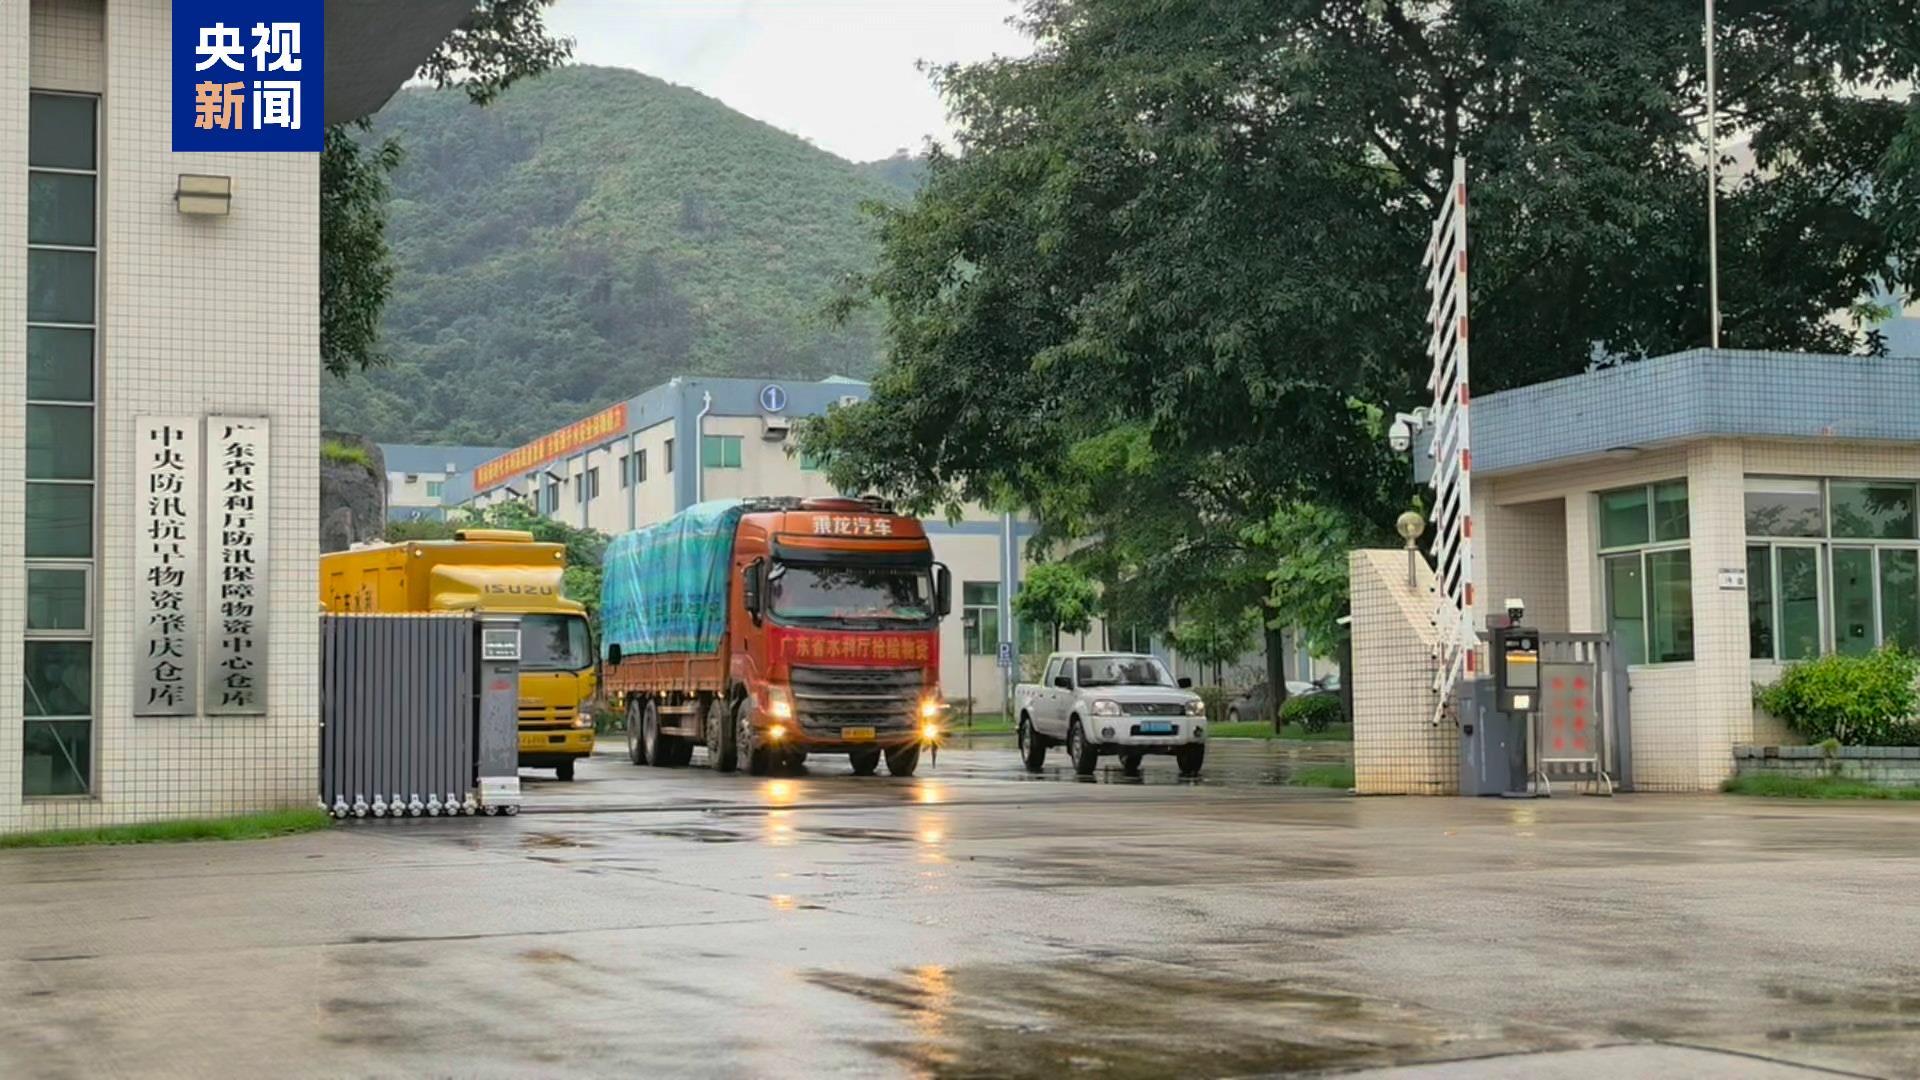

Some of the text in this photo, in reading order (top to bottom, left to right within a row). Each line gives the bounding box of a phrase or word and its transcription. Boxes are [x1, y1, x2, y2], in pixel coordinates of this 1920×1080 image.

[812, 514, 893, 536] 乘龙汽车
[147, 425, 186, 707] 中央防汛抗旱物资肇庆仓库
[220, 424, 256, 707] 广东省水利厅防汛保障物资中心仓库
[484, 584, 553, 596] ISUZU
[780, 634, 929, 661] 广东省水利厅抢险物资
